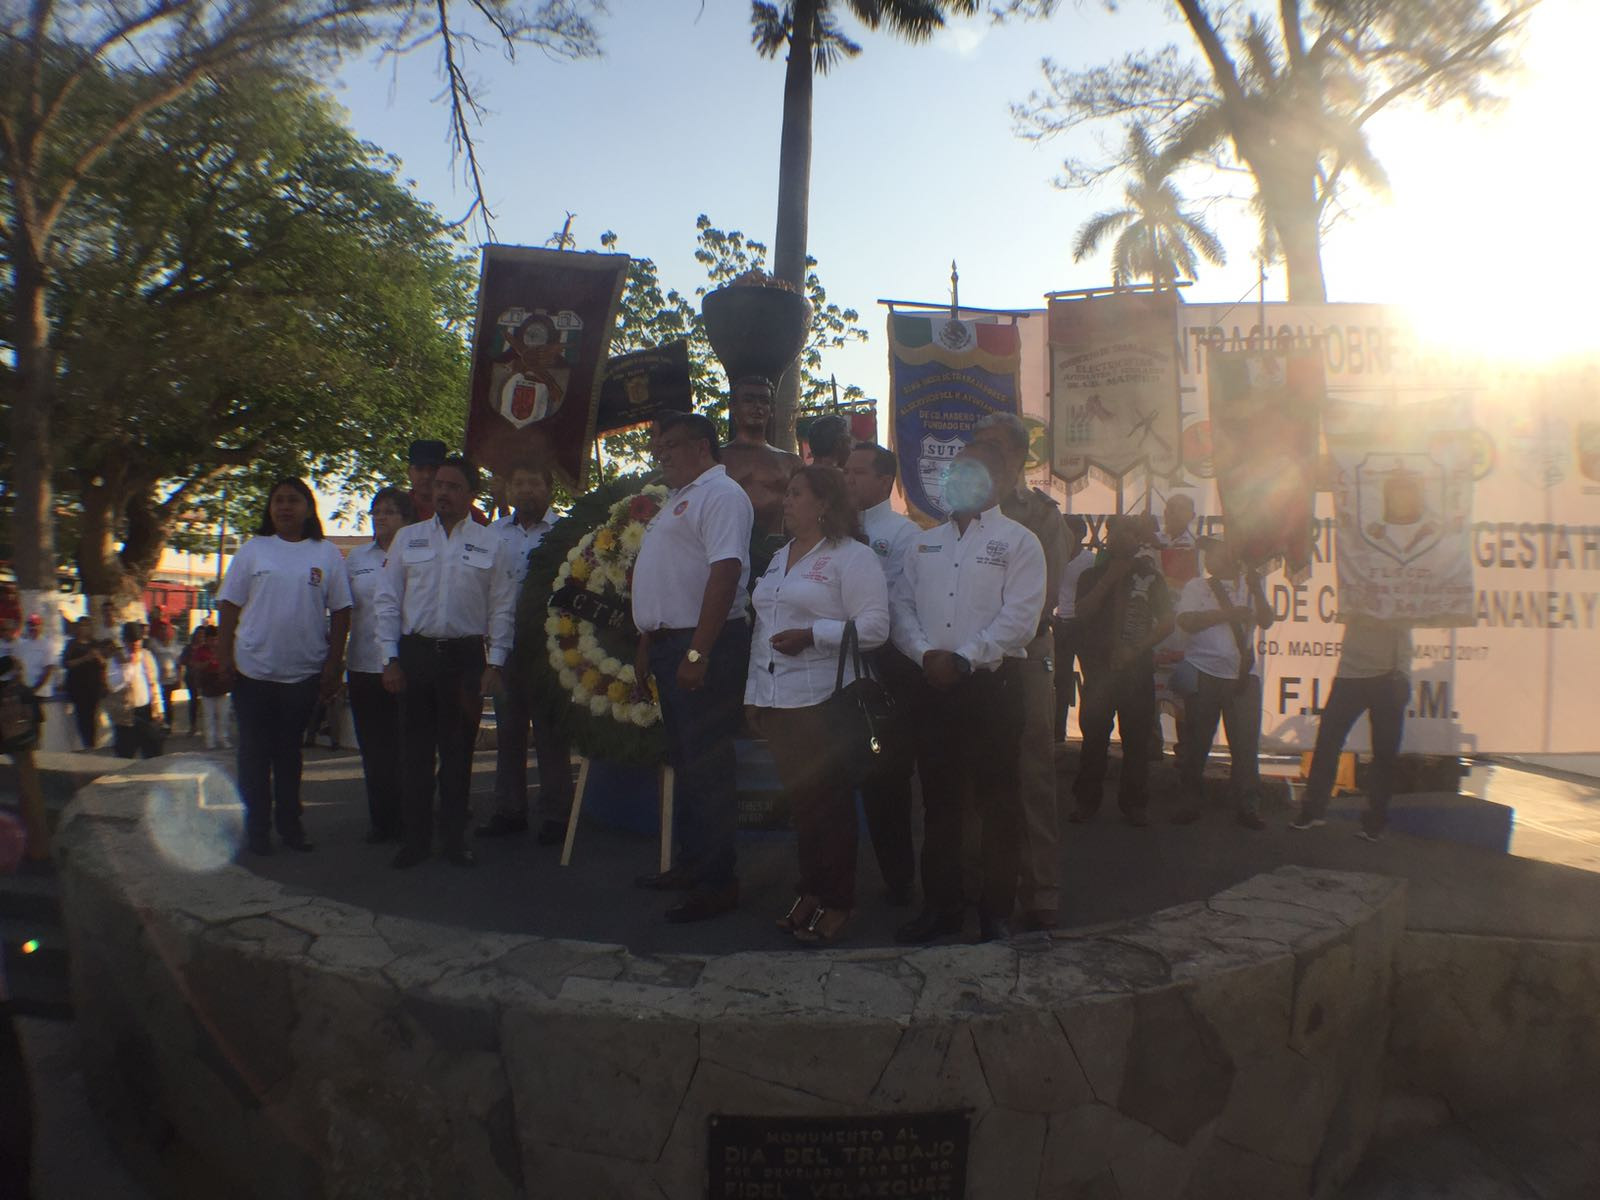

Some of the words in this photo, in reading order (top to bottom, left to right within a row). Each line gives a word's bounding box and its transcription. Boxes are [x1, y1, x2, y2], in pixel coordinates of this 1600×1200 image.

[1474, 522, 1577, 570] GESTA
[1581, 525, 1600, 570] H
[1274, 584, 1309, 622] DE
[1476, 590, 1579, 629] ANANEA
[1257, 640, 1283, 656] CD.
[1288, 640, 1344, 657] MADER
[766, 1129, 885, 1144] MONUMENTO
[895, 1127, 919, 1141] AL
[724, 1146, 767, 1164] DIA
[783, 1147, 829, 1164] DEL
[841, 1140, 956, 1164] TRABAJO
[724, 1181, 785, 1198] FIDEL
